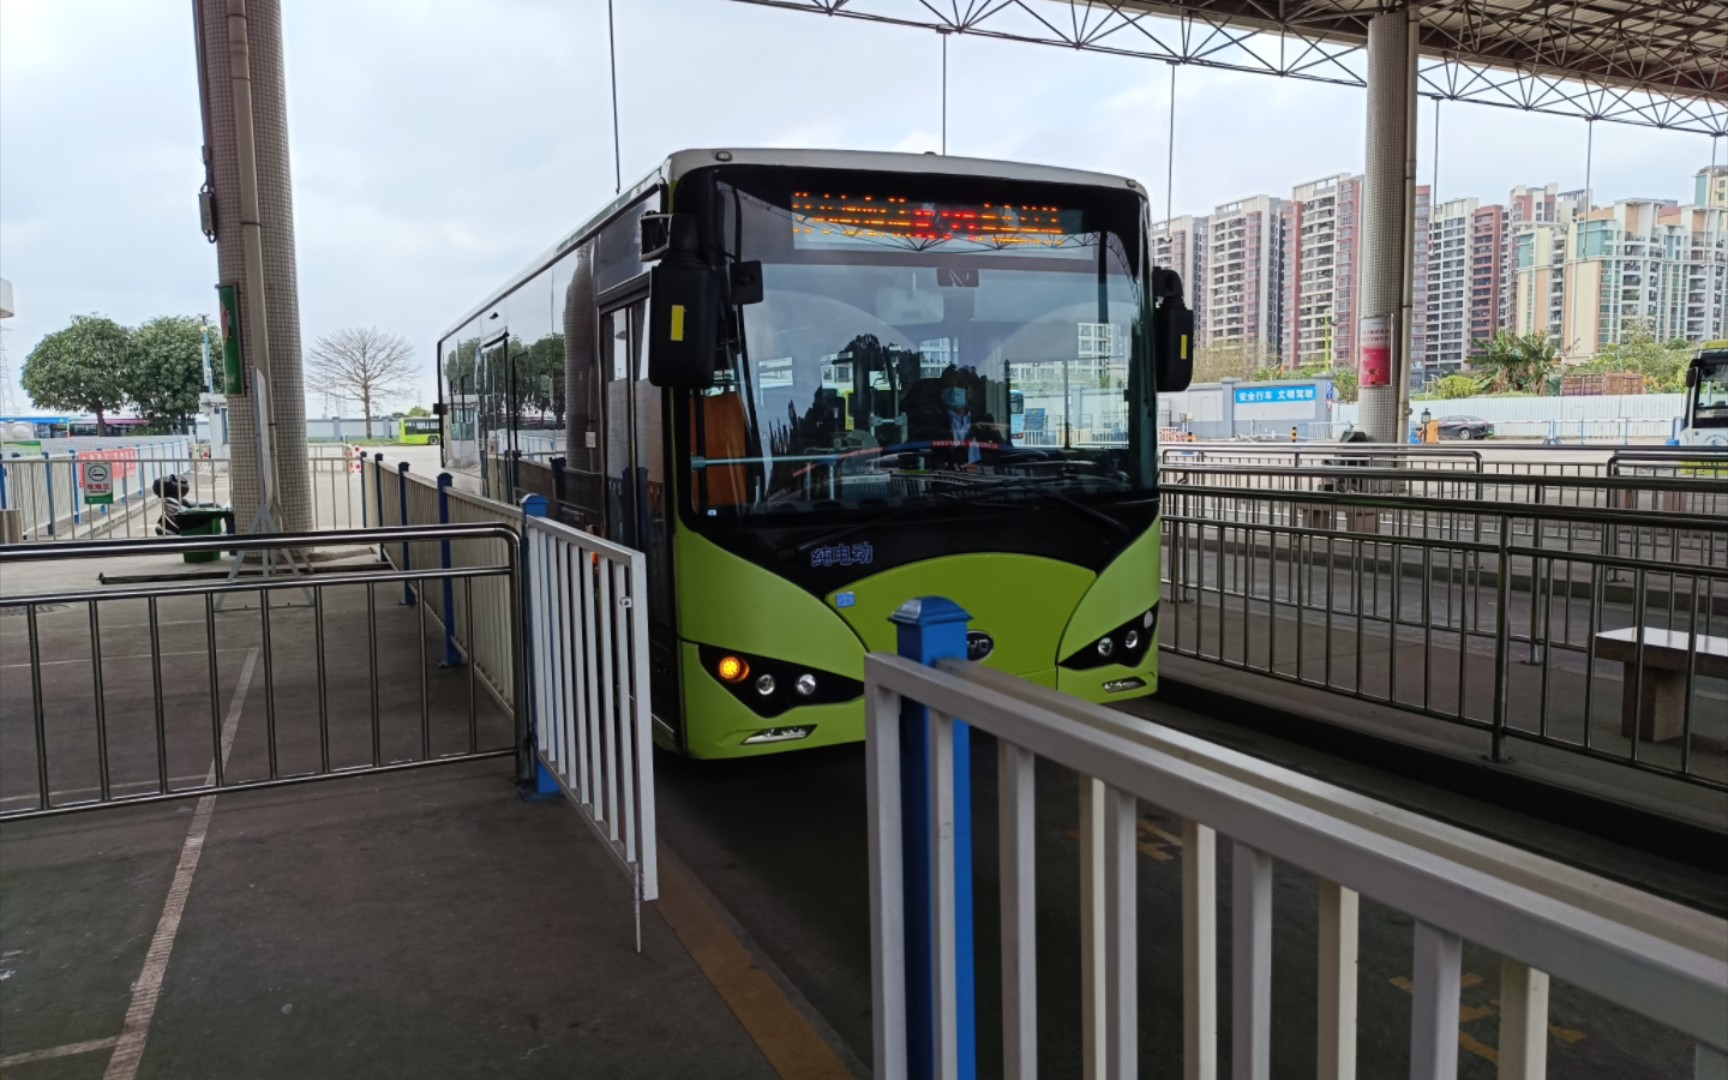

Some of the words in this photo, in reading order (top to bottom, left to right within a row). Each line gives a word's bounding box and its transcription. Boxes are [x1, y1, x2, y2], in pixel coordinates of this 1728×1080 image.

[1239, 391, 1272, 401] 安全行车
[1277, 389, 1313, 399] 文明驾驶
[811, 541, 872, 567] 纯电动
